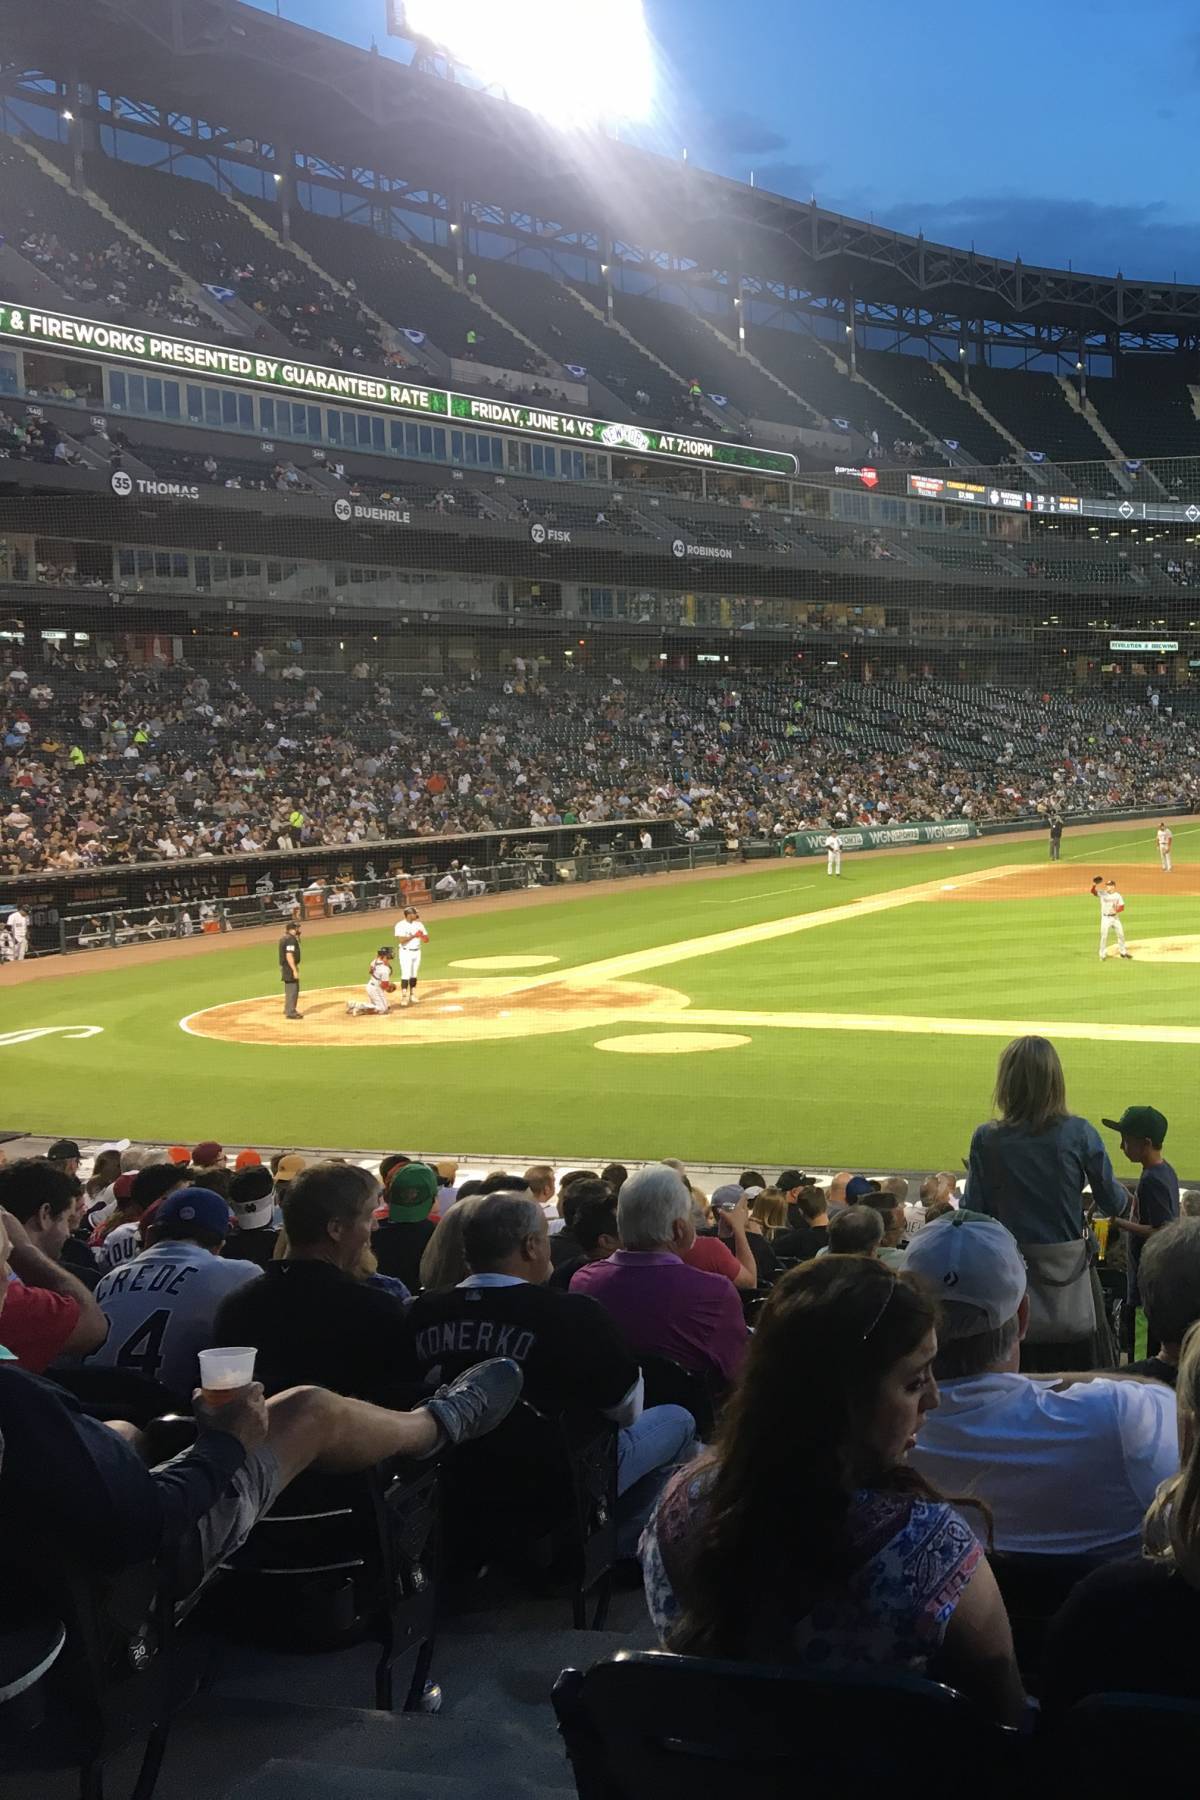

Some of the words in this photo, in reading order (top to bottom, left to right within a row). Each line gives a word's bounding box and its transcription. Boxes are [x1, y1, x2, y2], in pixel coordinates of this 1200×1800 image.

[10, 310, 24, 331] &
[30, 314, 145, 354] FIREWORKS
[150, 338, 251, 374] PRESENTED
[256, 360, 278, 379] BY
[282, 365, 387, 399] GUARANTEED
[390, 385, 430, 408] RATE
[471, 401, 523, 427] FRIDAY,
[527, 411, 559, 431] JUNE
[561, 418, 574, 434] 14
[578, 421, 594, 437] VS
[660, 435, 674, 450] AT
[678, 440, 713, 458] 7:10PM
[115, 478, 130, 489] 35
[136, 479, 200, 499] THOMAS
[336, 503, 349, 515] 56
[354, 506, 410, 524] BUEHRLE
[533, 528, 544, 539] 72
[547, 530, 571, 542] FISK
[674, 543, 684, 553] 42
[687, 545, 732, 559] ROBINSON
[870, 831, 893, 844] WGN
[925, 827, 946, 839] WGN
[96, 1264, 199, 1303] CREDE
[415, 1322, 535, 1361] KONERKO
[414, 1572, 423, 1582] 19
[133, 1645, 146, 1660] 20
